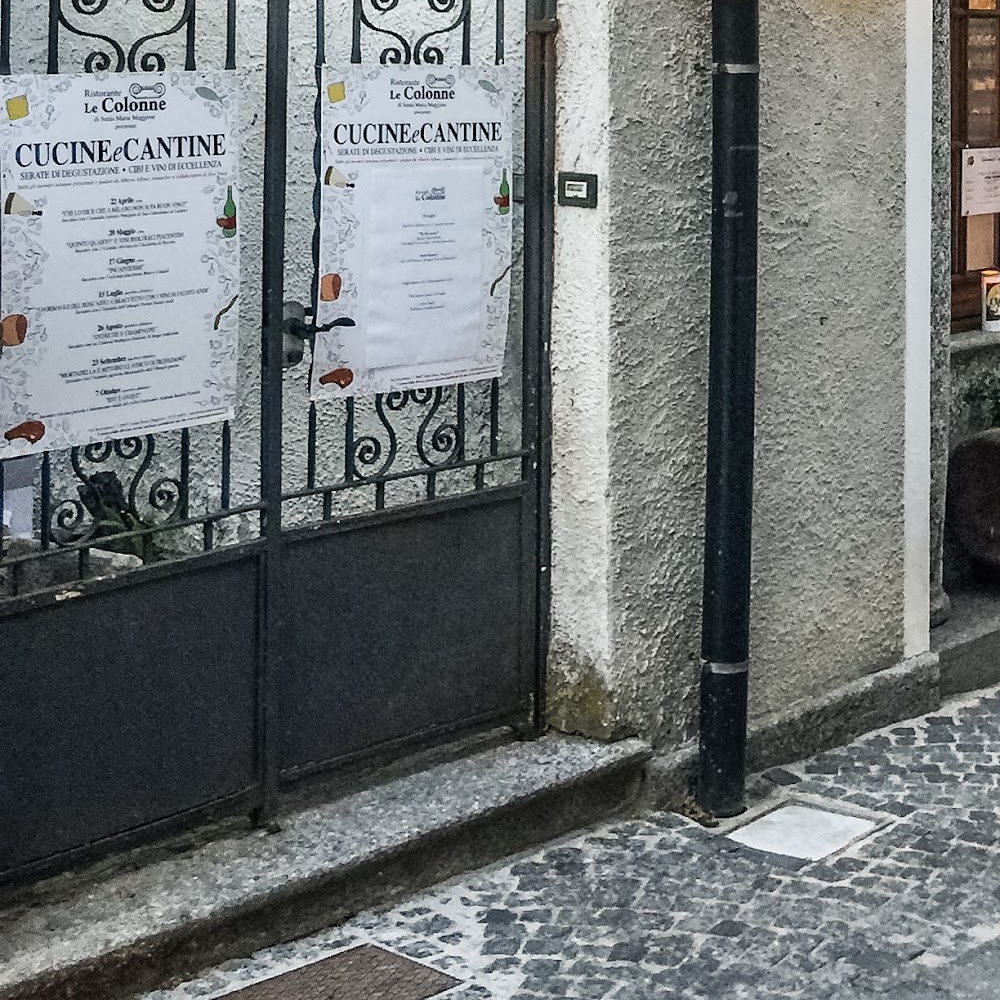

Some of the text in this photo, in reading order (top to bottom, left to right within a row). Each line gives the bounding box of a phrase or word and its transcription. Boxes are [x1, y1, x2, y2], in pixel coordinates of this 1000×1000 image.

[84, 89, 122, 98] Ristorante
[390, 85, 456, 100] Le Colonne
[84, 96, 167, 113] Le Colonne
[20, 170, 50, 181] SERATE
[51, 170, 60, 179] DI
[61, 166, 120, 178] DEGUSTAZIONE
[151, 163, 167, 172] VINI
[168, 163, 176, 171] DI
[177, 159, 222, 171] ECCELLENZA
